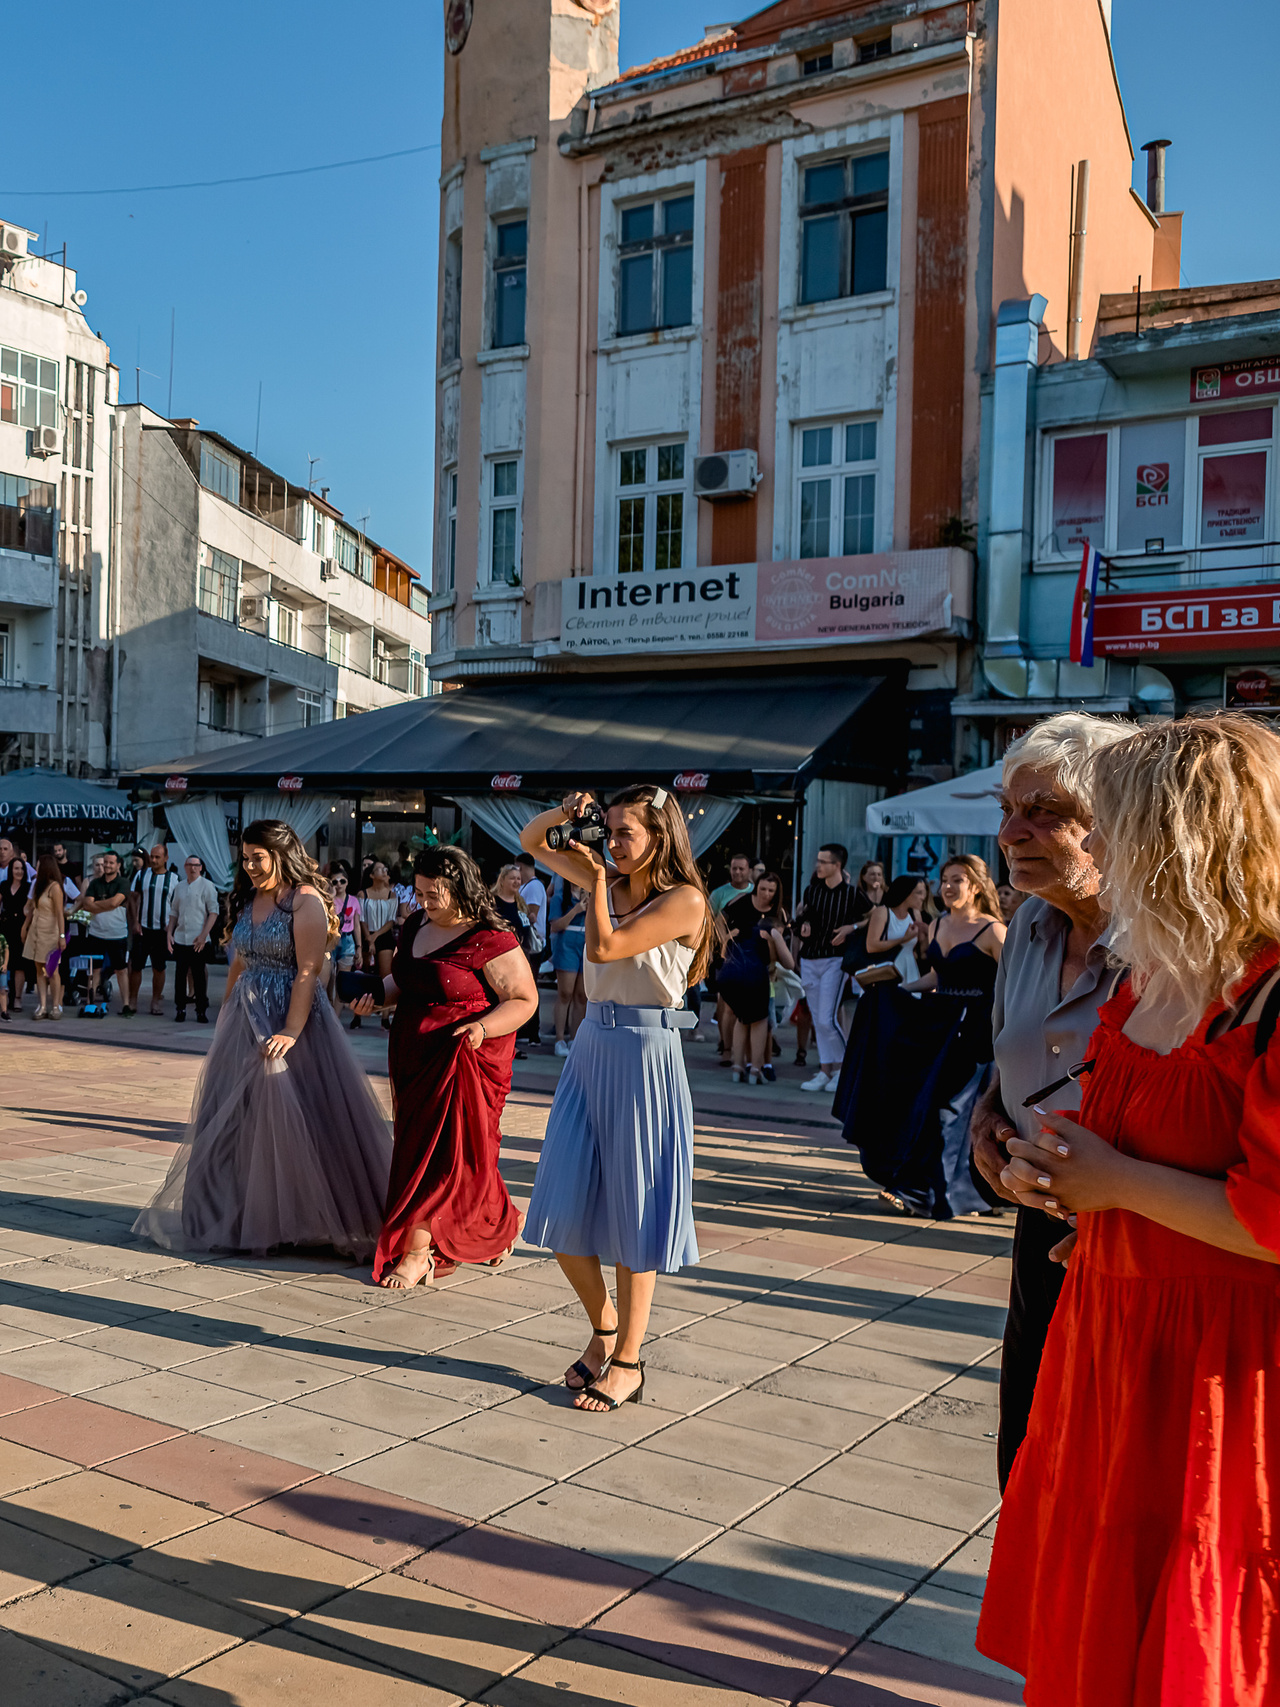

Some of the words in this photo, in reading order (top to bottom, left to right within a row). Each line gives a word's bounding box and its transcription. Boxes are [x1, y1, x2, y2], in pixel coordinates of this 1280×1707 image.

[1136, 493, 1169, 508] БСП
[771, 567, 816, 584] ComNet
[825, 568, 919, 591] ComNet
[578, 572, 741, 610] Internet
[764, 592, 820, 607] INTERNET
[829, 591, 905, 612] Bulgaria
[765, 613, 818, 632] BULGARIA
[1141, 604, 1209, 632] БСП
[1221, 607, 1259, 628] за
[817, 626, 836, 634] NEW
[838, 623, 890, 633] GENERATION
[566, 639, 578, 648] гр.
[580, 637, 610, 647] Айтос,
[1105, 640, 1160, 650] www.bsp.bg
